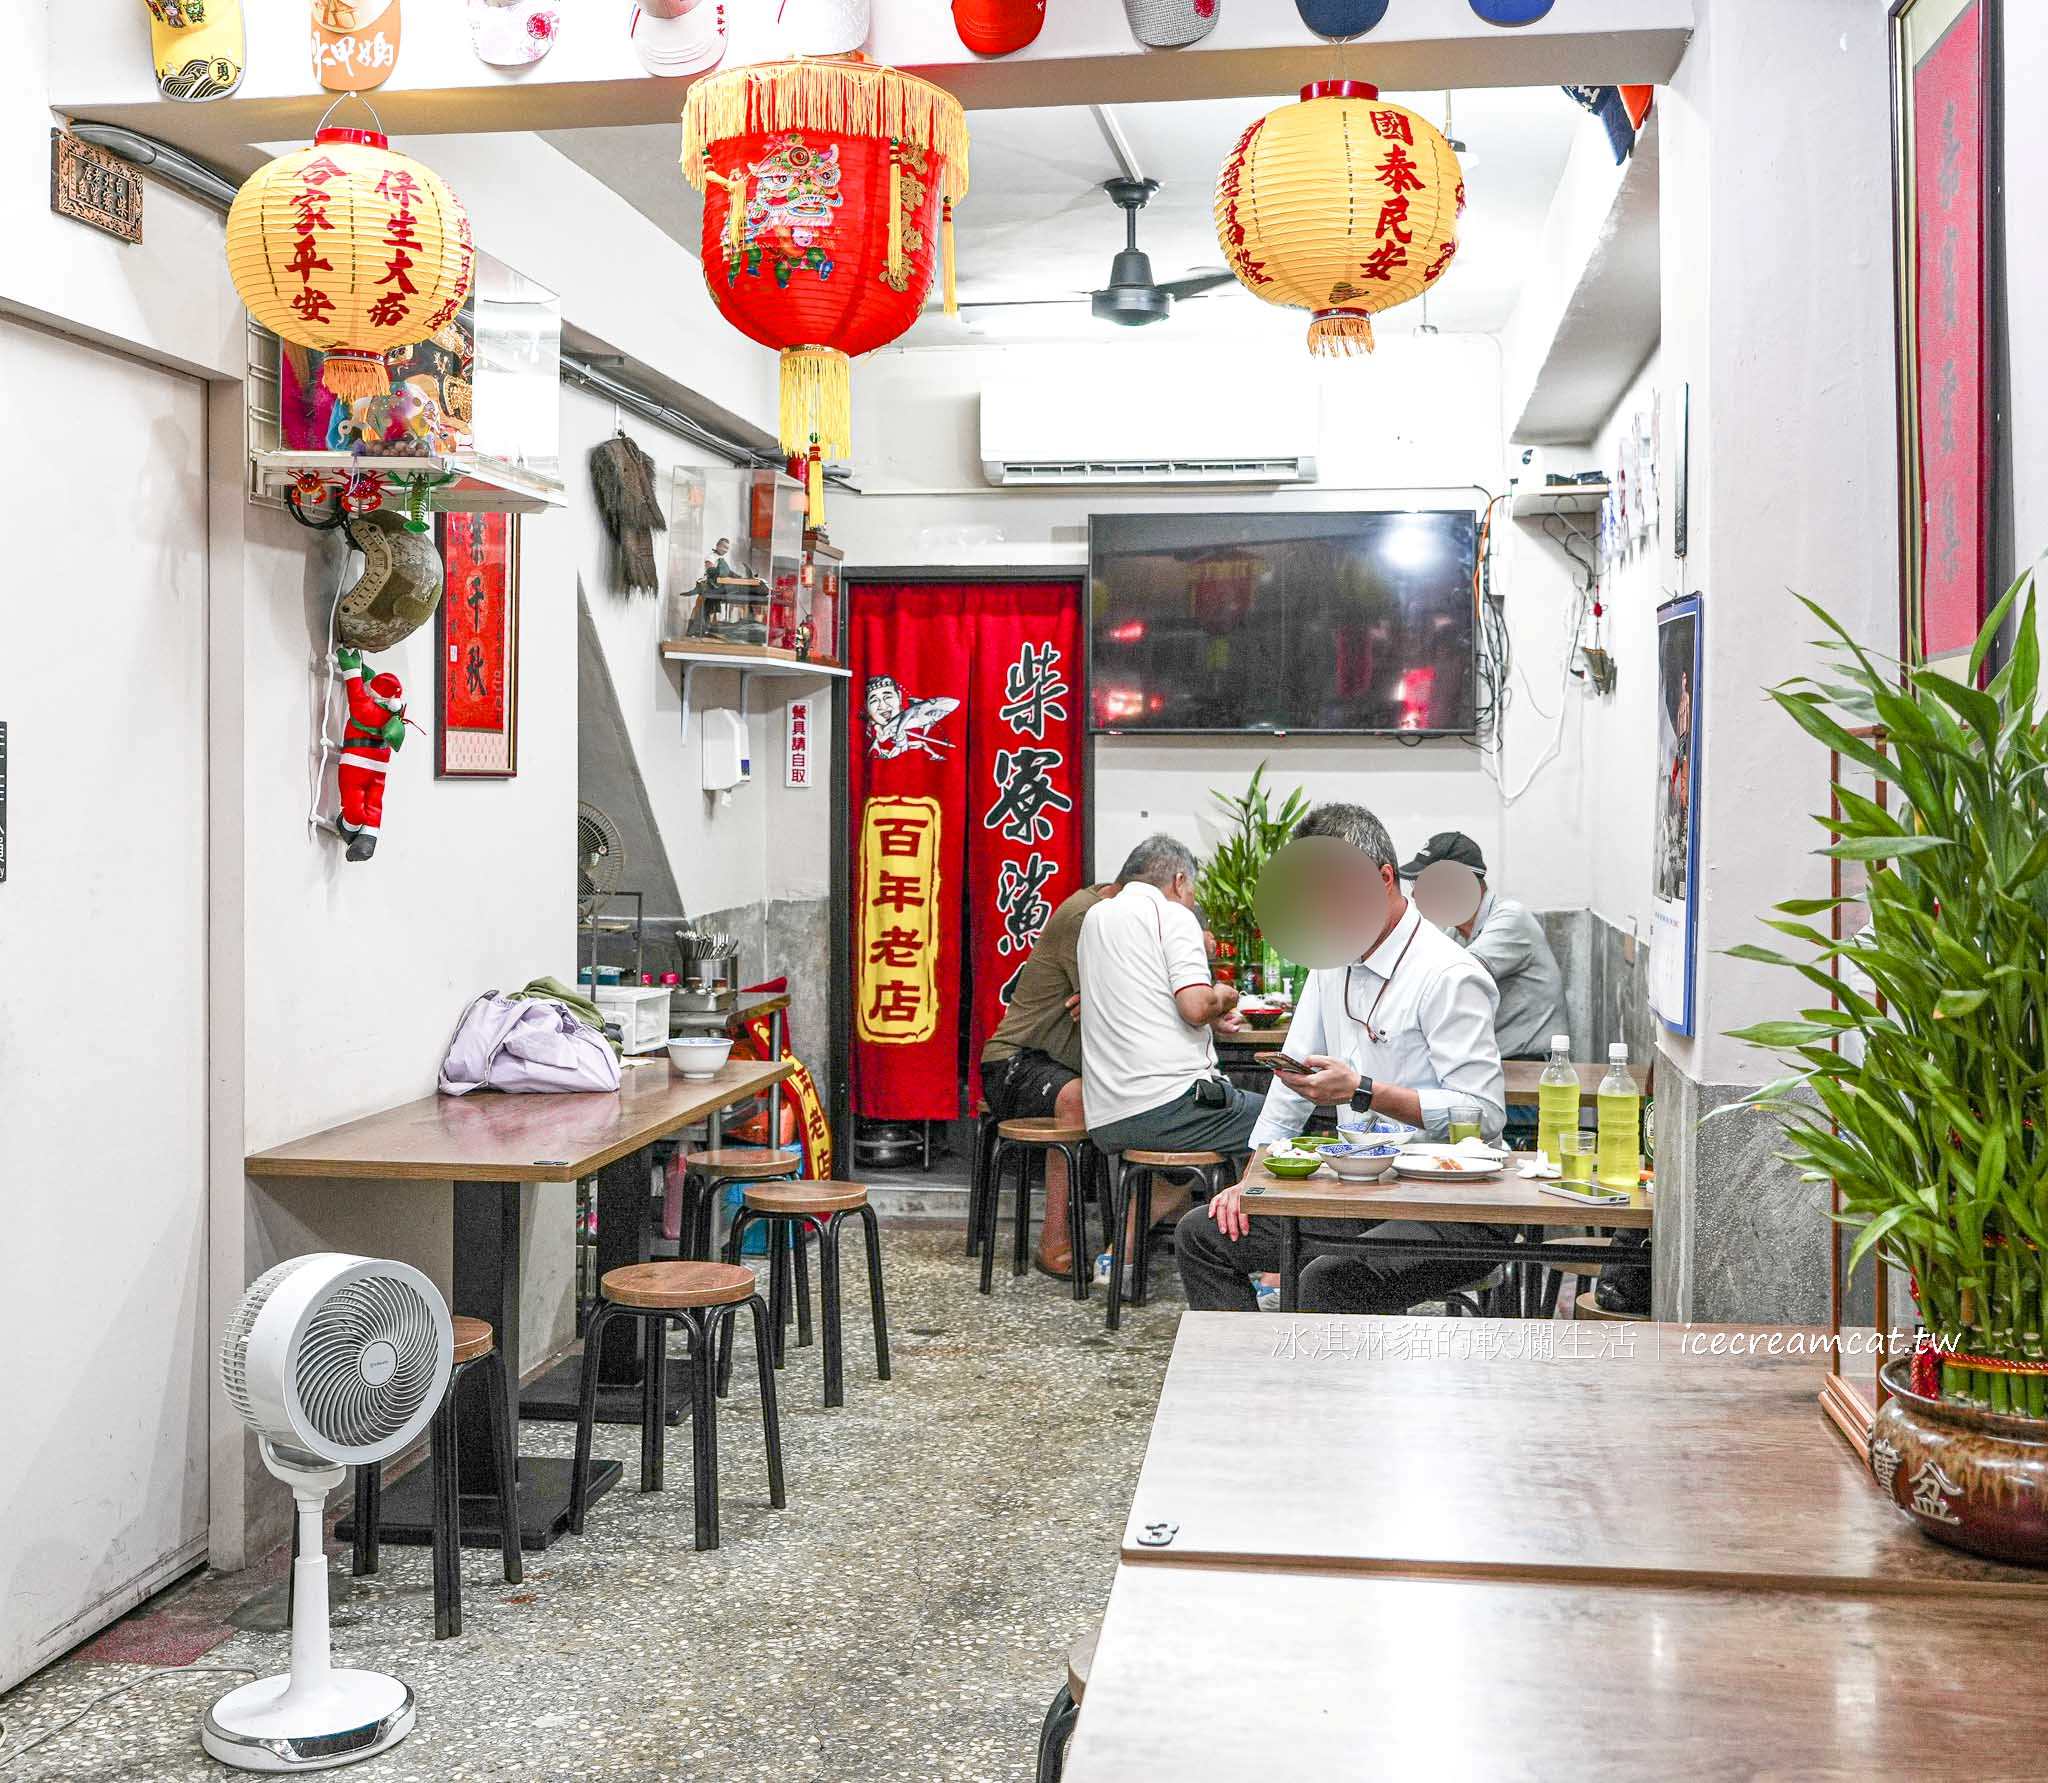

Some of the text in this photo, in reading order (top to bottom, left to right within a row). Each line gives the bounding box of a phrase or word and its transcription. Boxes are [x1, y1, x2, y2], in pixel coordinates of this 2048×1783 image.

[216, 61, 230, 82] 勇
[284, 156, 347, 325] 合家平安
[367, 169, 424, 328] 保生大帝
[1360, 110, 1426, 281] 國泰民安
[791, 704, 807, 783] 餐具請自取
[984, 641, 1073, 1007] 柴寮鯊
[868, 818, 929, 1023] 百年老店
